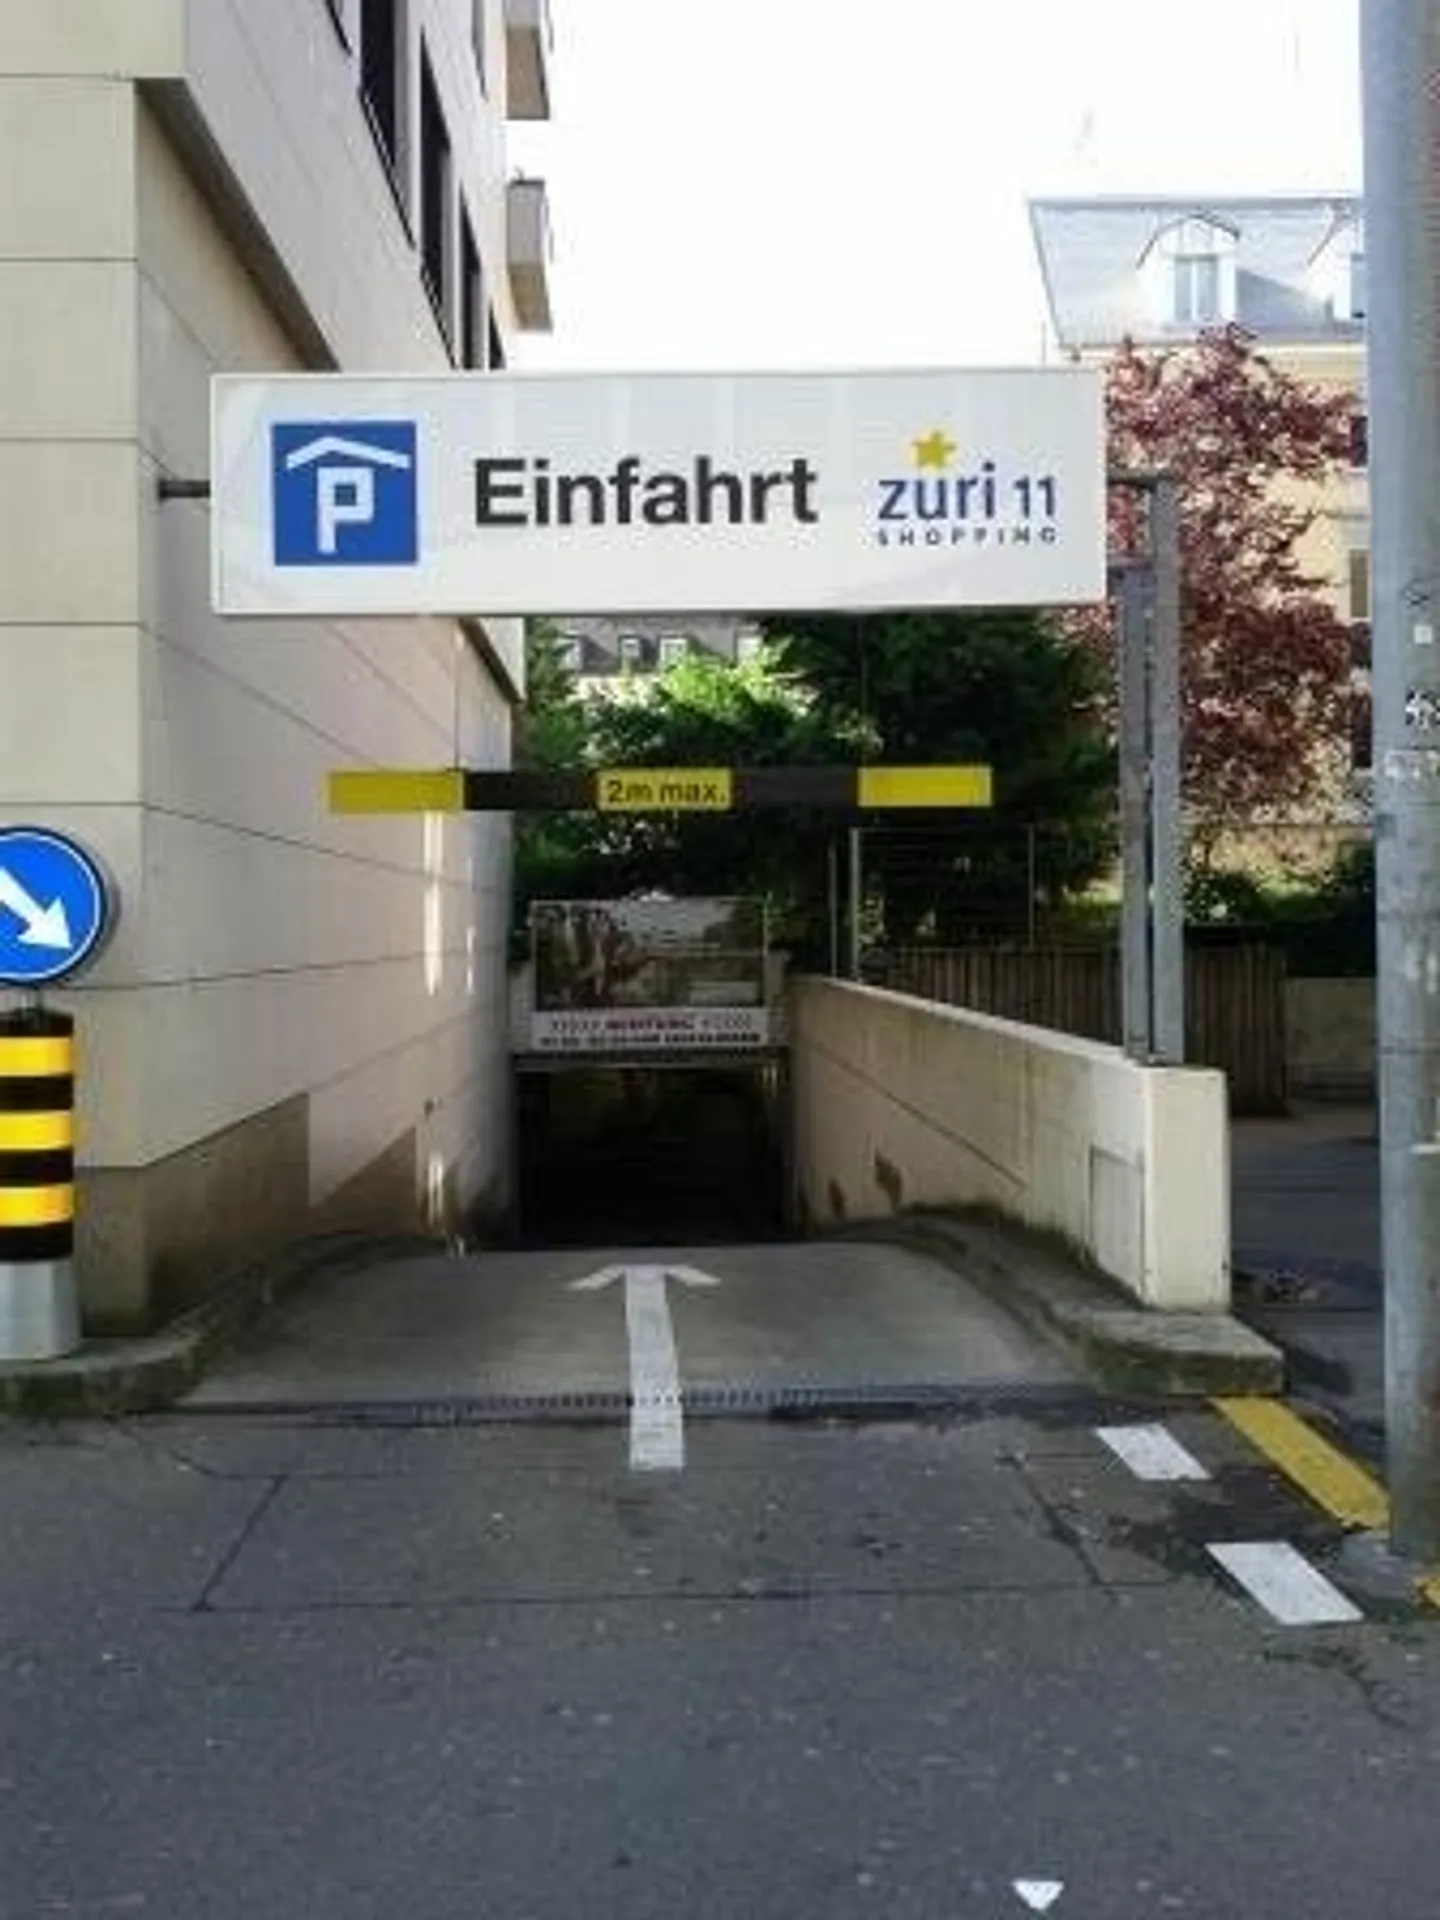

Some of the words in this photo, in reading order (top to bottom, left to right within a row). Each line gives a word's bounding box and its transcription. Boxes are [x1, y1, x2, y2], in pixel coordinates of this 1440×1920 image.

[317, 467, 374, 553] P
[475, 455, 819, 526] Einfahrt
[1013, 475, 1056, 519] 11
[878, 527, 1057, 546] SHOPPING
[608, 780, 653, 803] 2m
[660, 783, 726, 803] max.
